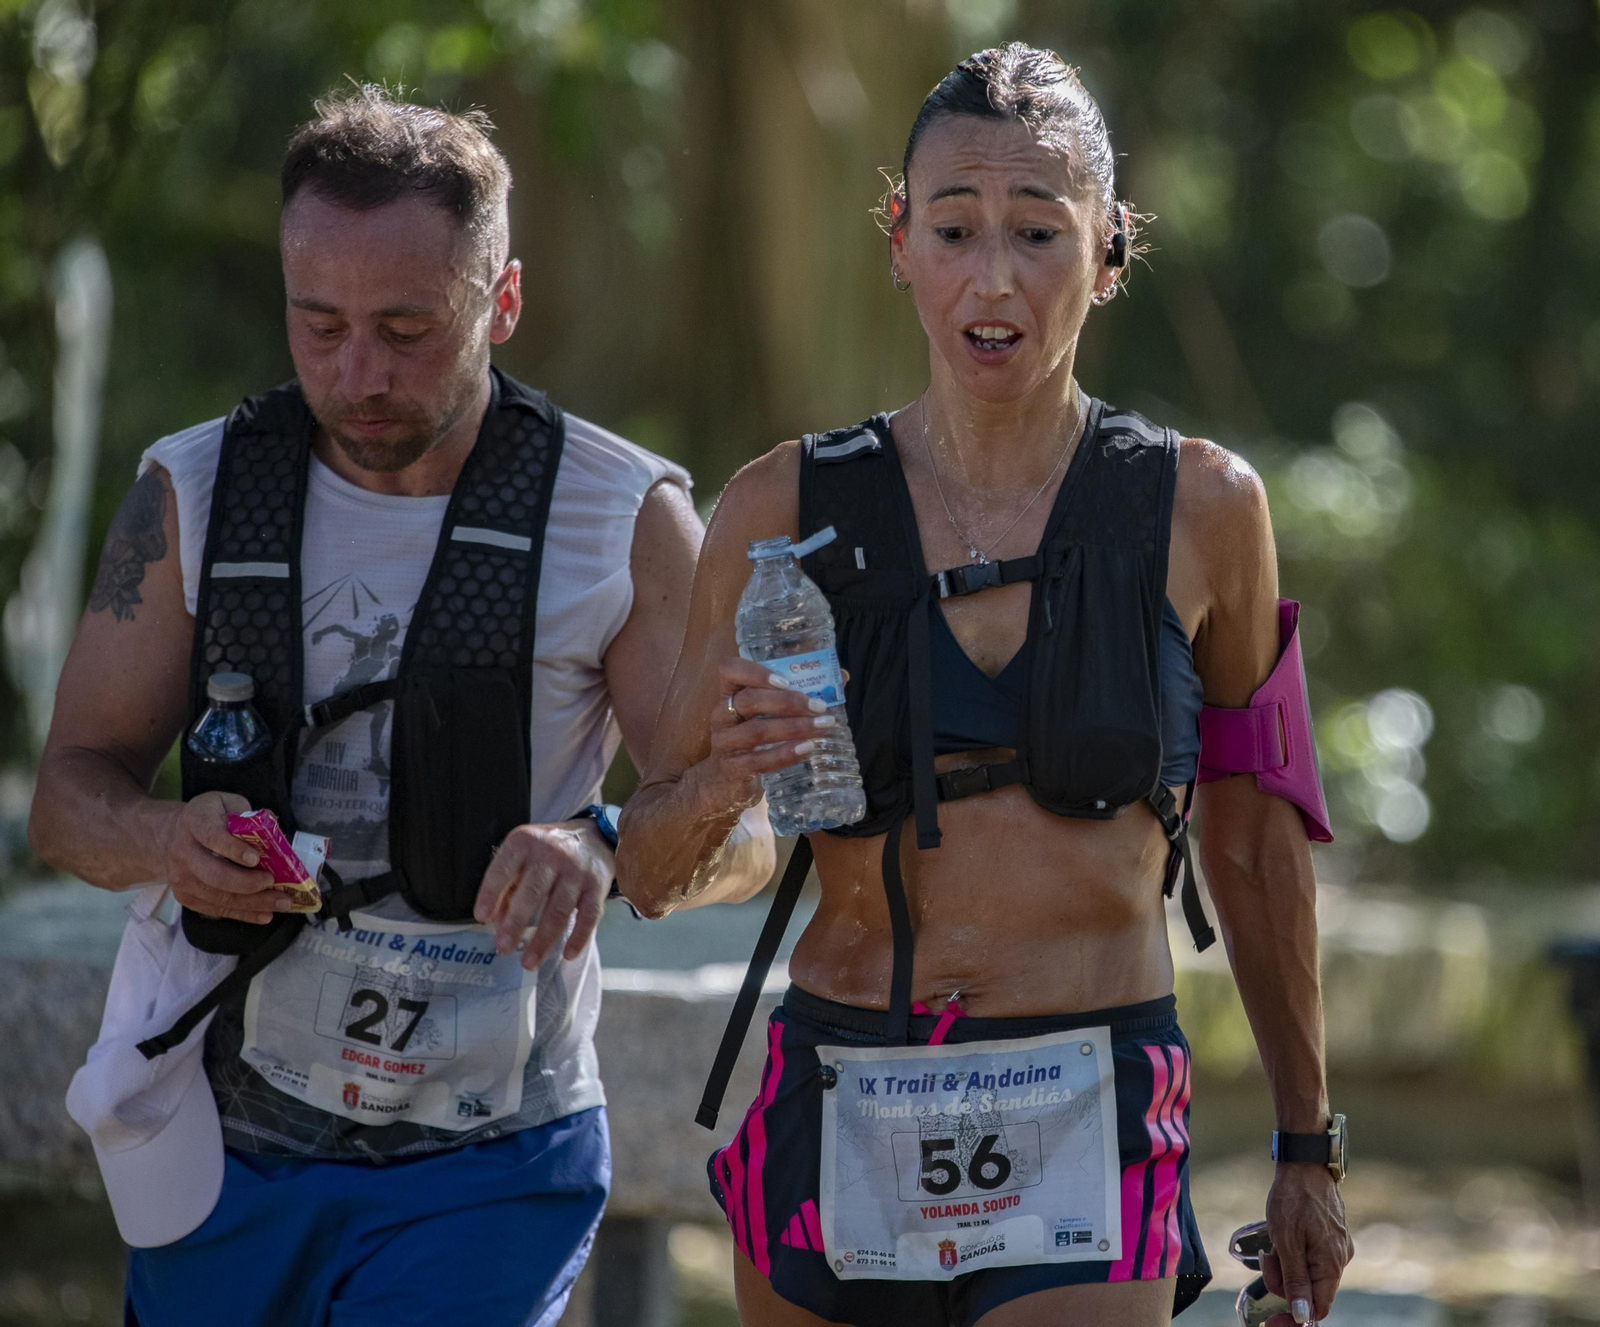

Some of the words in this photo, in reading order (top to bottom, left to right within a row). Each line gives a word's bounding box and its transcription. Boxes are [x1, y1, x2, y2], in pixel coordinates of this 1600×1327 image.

[389, 934, 406, 951] &
[410, 939, 496, 965] Andaina
[384, 957, 411, 976] de
[345, 989, 429, 1052] 27
[341, 1047, 380, 1069] EDGAR
[383, 1060, 426, 1075] GOMEZ
[859, 1077, 877, 1095] IX
[884, 1073, 936, 1096] Trail
[943, 1072, 960, 1092] &
[966, 1064, 1062, 1091] Andaina
[856, 1098, 939, 1121] Montes
[946, 1095, 973, 1115] de
[979, 1085, 1075, 1113] Sandiás
[921, 1134, 1011, 1195] 56
[920, 1201, 980, 1220] YOLANDA
[983, 1195, 1021, 1213] SOUTO
[1059, 1216, 1082, 1224] Tempos
[957, 1221, 972, 1229] TRAIL
[959, 1236, 995, 1253] CONCELLO
[996, 1234, 1005, 1242] DE
[960, 1241, 1006, 1263] SANDIÁS
